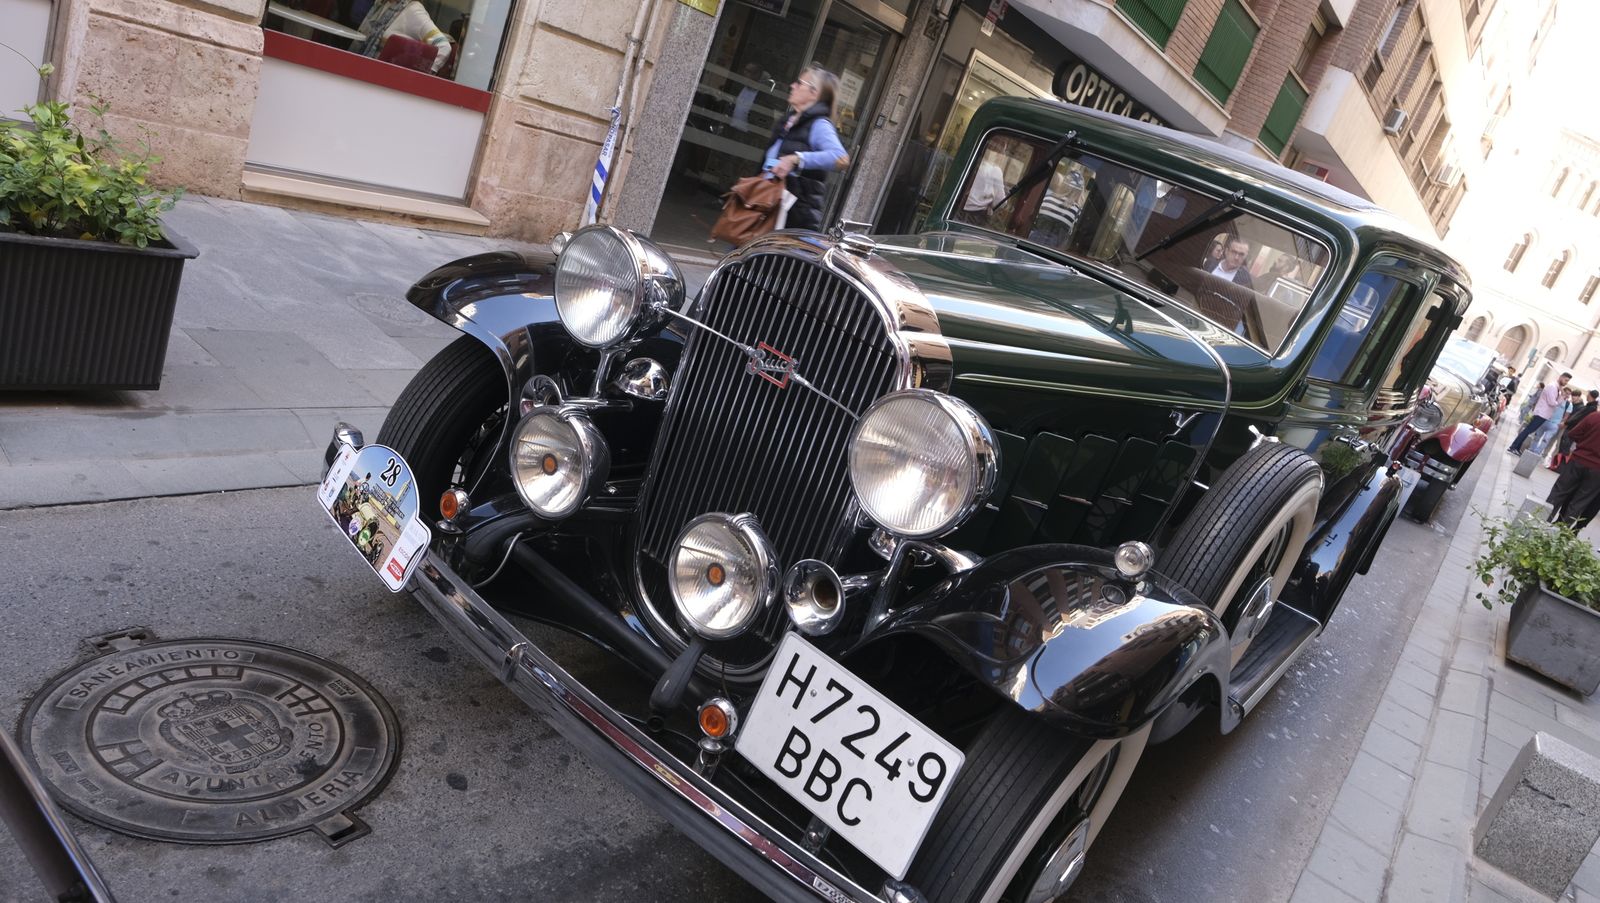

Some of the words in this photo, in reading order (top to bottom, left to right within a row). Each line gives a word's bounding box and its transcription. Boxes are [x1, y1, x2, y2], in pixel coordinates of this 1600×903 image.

[1066, 64, 1133, 118] OPTICA
[602, 134, 613, 156] PASAR
[380, 457, 402, 487] 28
[69, 648, 240, 699] SANEAMIENTO
[236, 769, 364, 828] ALMERIA
[773, 725, 873, 827] BBC
